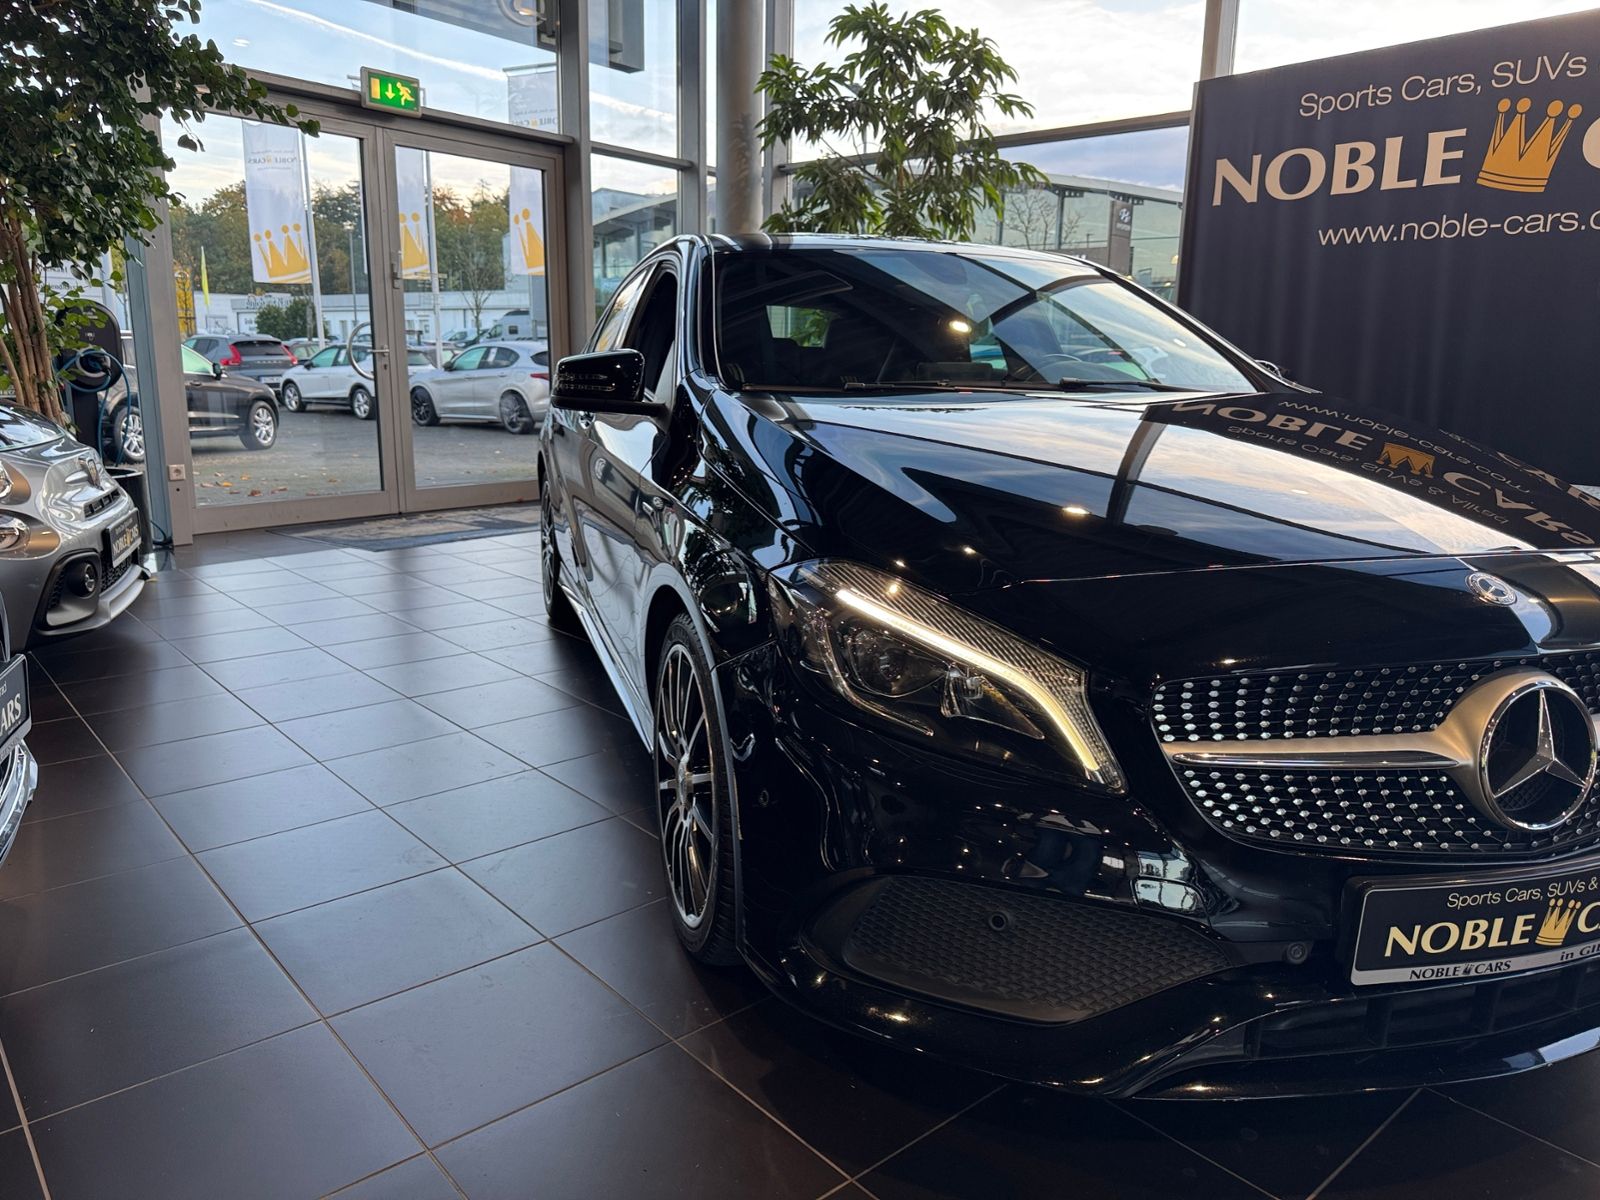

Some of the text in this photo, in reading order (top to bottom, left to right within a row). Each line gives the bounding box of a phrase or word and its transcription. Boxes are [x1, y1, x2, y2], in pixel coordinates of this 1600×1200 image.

[1299, 51, 1587, 120] Sports Cars, SUVs
[1212, 128, 1468, 207] NOBLE
[1447, 876, 1599, 910] Sports Cars, SUVs &
[1384, 913, 1536, 957] NOBLE
[1409, 960, 1512, 980] NOBLE CARS
[1560, 951, 1575, 961] in
